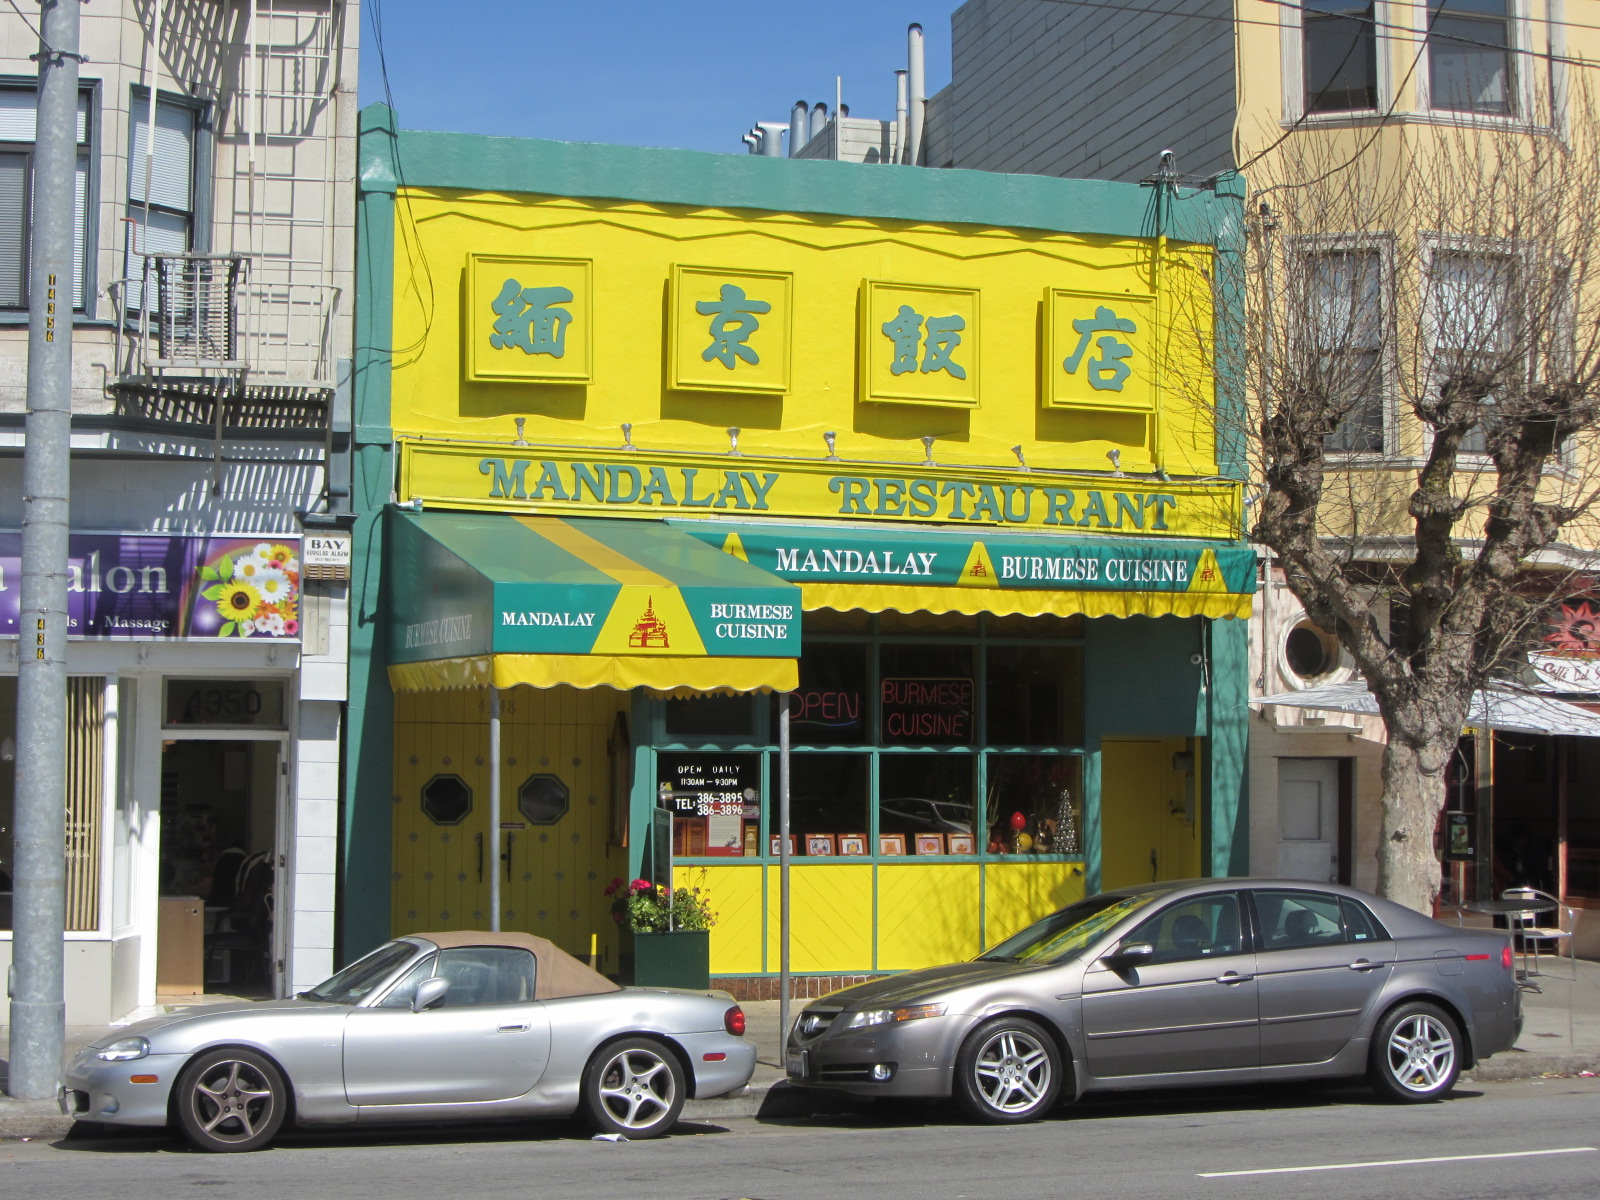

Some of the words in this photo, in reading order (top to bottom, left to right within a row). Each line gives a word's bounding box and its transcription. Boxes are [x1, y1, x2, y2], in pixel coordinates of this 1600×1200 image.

[479, 458, 780, 511] MANDALAY
[828, 476, 1176, 531] RESTAURANT
[311, 540, 345, 550] BAY
[67, 550, 170, 593] alon
[775, 549, 937, 576] MANDALAY
[1001, 556, 1098, 581] BURMESE
[1105, 558, 1188, 583] CUISINE
[105, 615, 170, 632] Massage
[502, 612, 596, 627] MANDALAY
[710, 603, 794, 620] BURMESE
[405, 620, 439, 648] BURMESE
[440, 614, 473, 643] CUISINE
[715, 623, 788, 639] CUISINE
[187, 689, 262, 715] 4350
[882, 682, 970, 705] BURMESE
[788, 692, 859, 719] OPEN
[887, 713, 964, 737] CUISINE
[677, 766, 702, 774] OPEN
[712, 765, 741, 774] DAILY
[681, 778, 705, 786] 11:30AM
[715, 778, 738, 786] 9:30PM
[675, 798, 697, 810] TEL:
[697, 793, 743, 804] 386-3895
[697, 805, 743, 816] 386-3896
